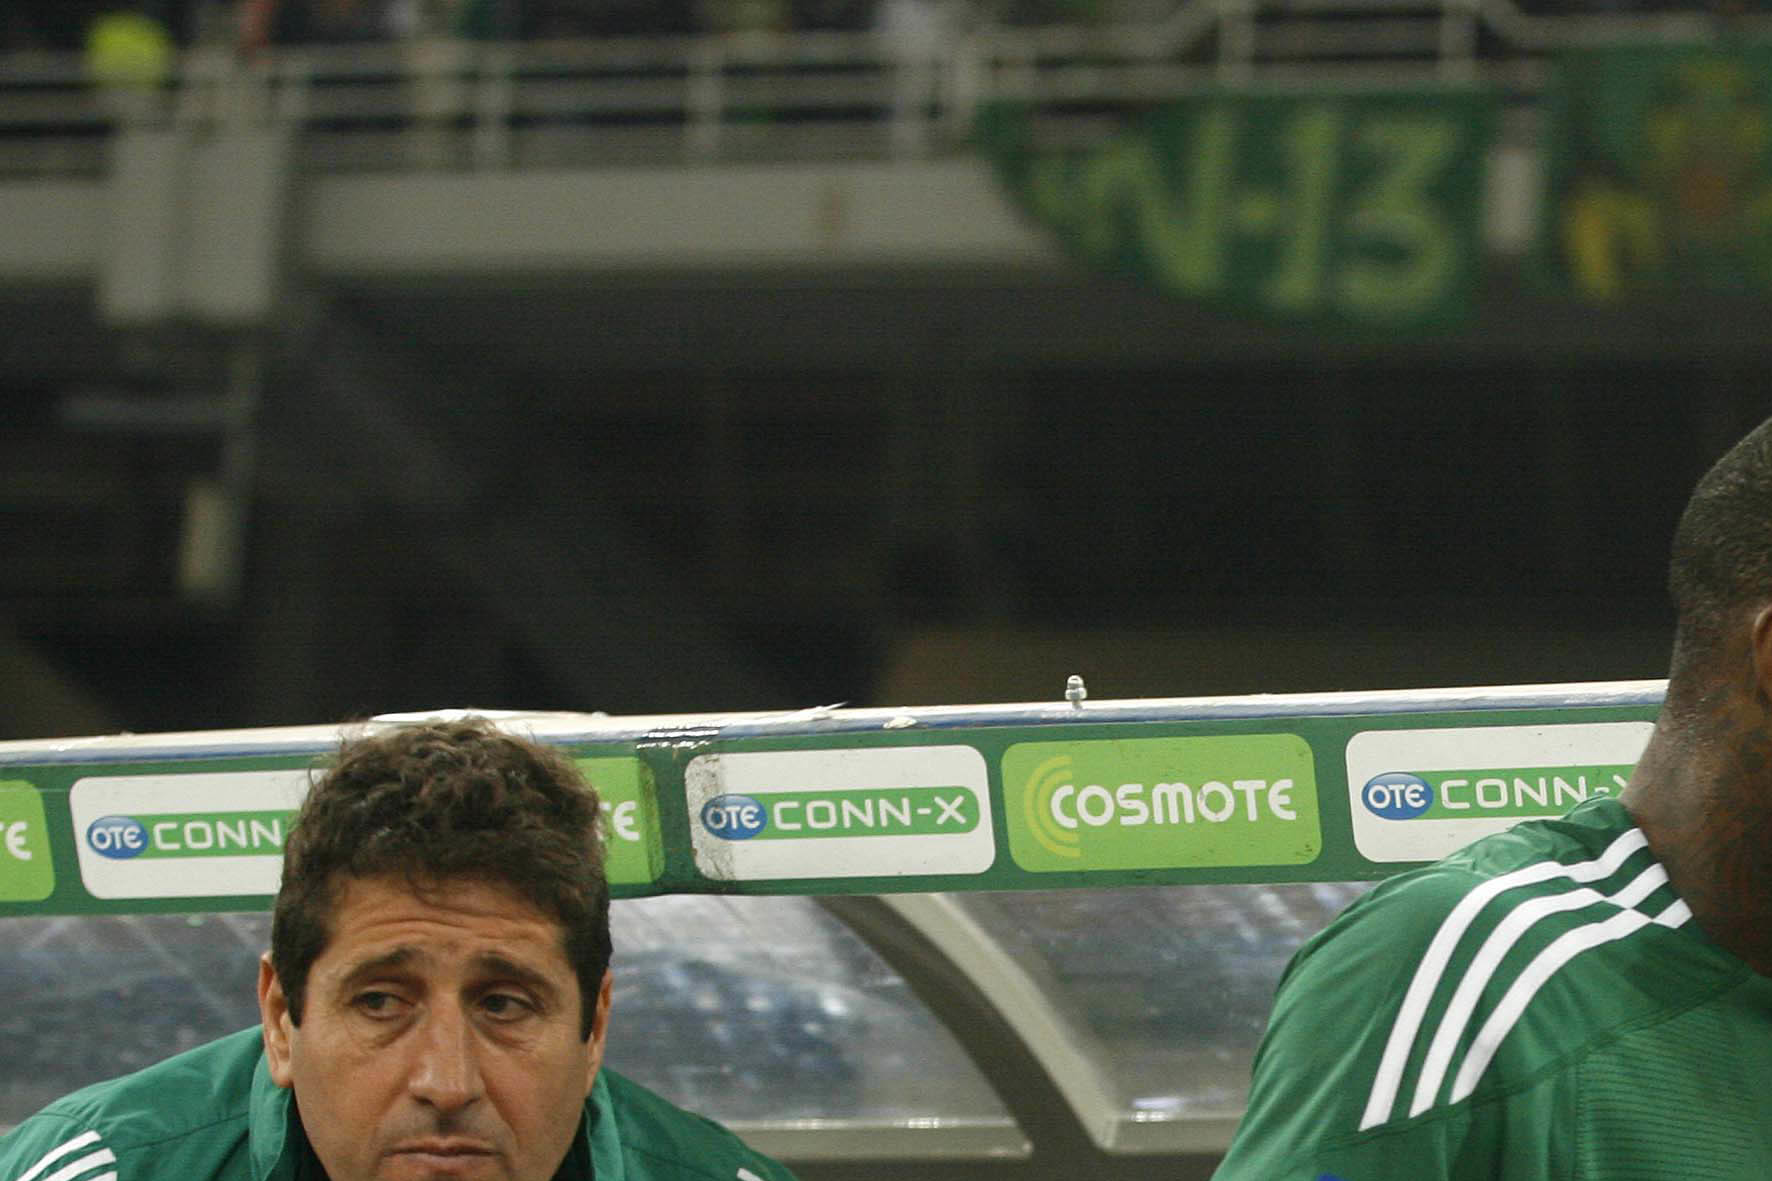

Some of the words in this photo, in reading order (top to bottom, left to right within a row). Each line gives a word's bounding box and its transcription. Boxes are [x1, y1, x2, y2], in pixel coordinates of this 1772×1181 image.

[1049, 778, 1297, 829] COSMOTE
[1366, 783, 1426, 809] OTE
[1440, 774, 1625, 809] CONN-
[703, 808, 761, 831] OTE
[772, 793, 967, 830] CONN-X
[90, 825, 143, 852] OTE
[154, 817, 283, 850] CONN
